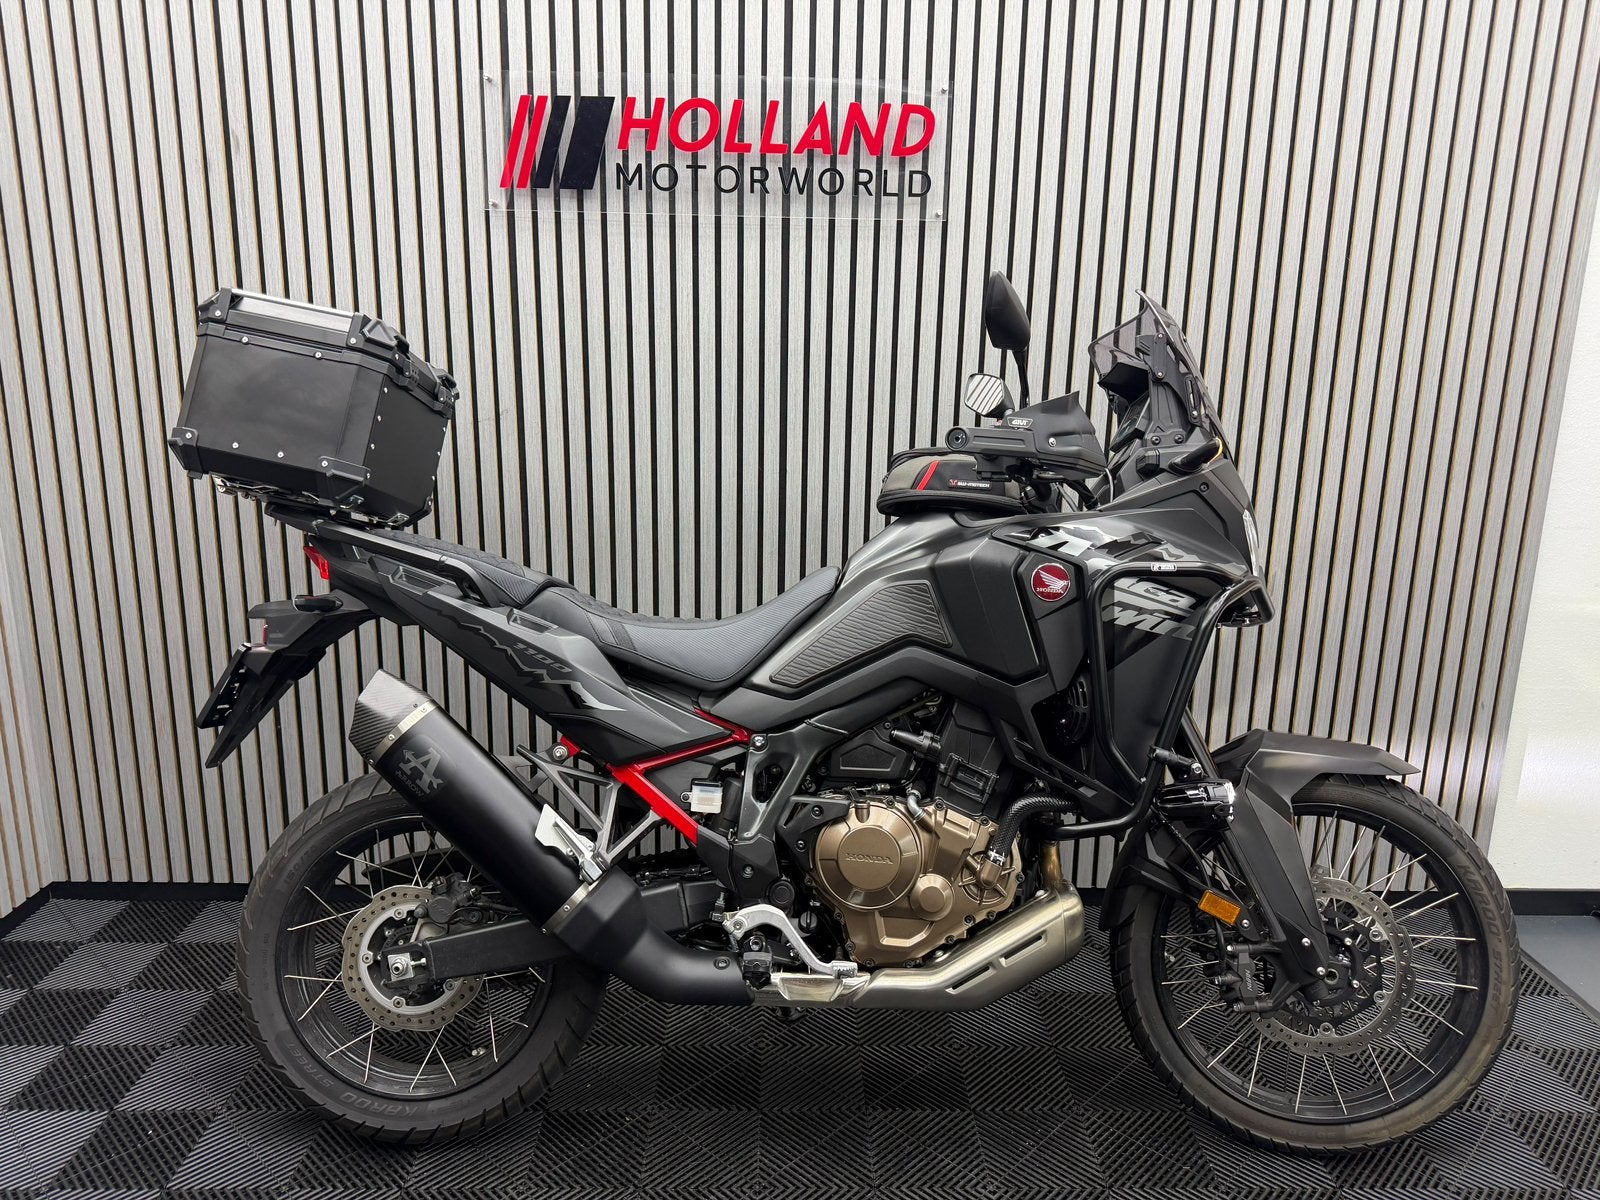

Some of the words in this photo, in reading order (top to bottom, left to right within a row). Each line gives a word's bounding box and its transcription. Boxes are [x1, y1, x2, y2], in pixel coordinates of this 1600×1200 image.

[616, 96, 936, 158] HOLLAND
[616, 162, 933, 198] MOTORWORLD
[846, 853, 893, 864] HONDA
[1491, 948, 1503, 1014] STREET
[284, 1041, 334, 1088] STREET
[339, 1091, 418, 1117] KAROO
